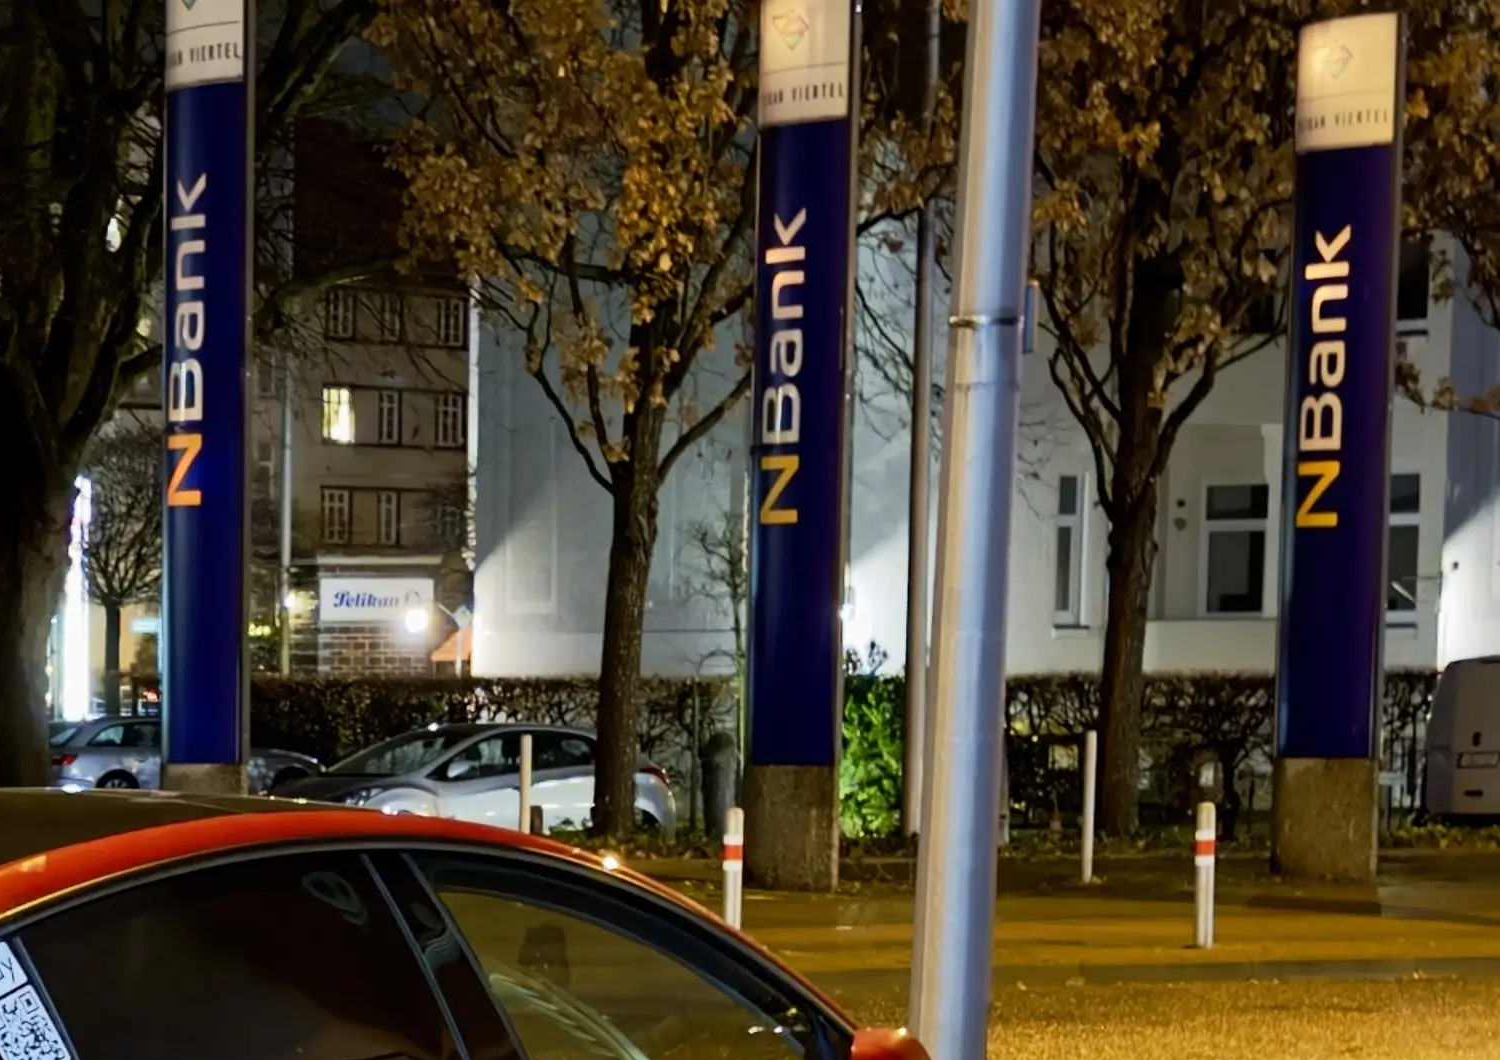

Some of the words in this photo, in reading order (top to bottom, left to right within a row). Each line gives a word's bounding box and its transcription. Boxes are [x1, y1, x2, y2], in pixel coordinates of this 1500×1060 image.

[189, 42, 240, 65] VIERTEL
[791, 82, 844, 104] VIERTEL
[1334, 108, 1388, 128] VIERTEL
[333, 590, 400, 609] Pelikan
